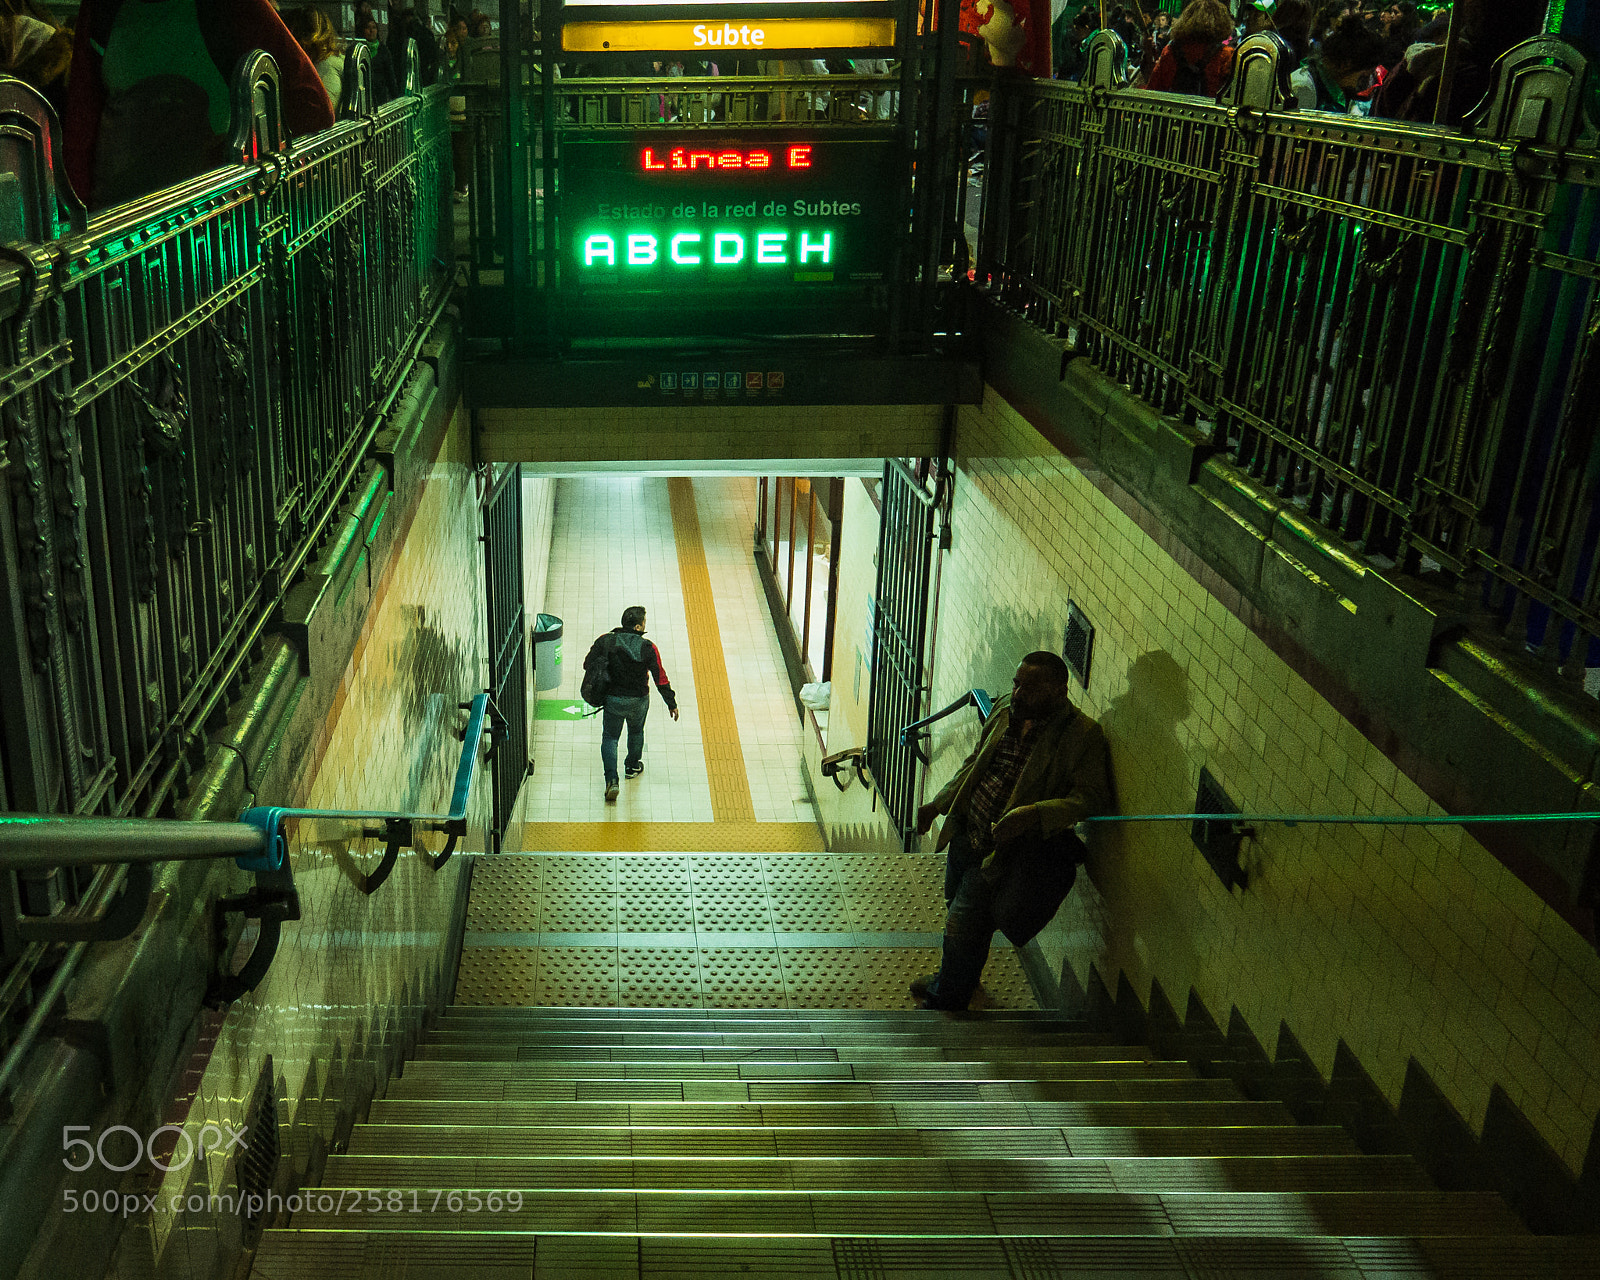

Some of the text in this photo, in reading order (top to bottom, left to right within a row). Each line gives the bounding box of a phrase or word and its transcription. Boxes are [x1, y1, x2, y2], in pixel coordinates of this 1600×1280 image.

[693, 23, 765, 46] Subte
[789, 146, 811, 168] E
[598, 199, 862, 219] Estado de la red de Subtes
